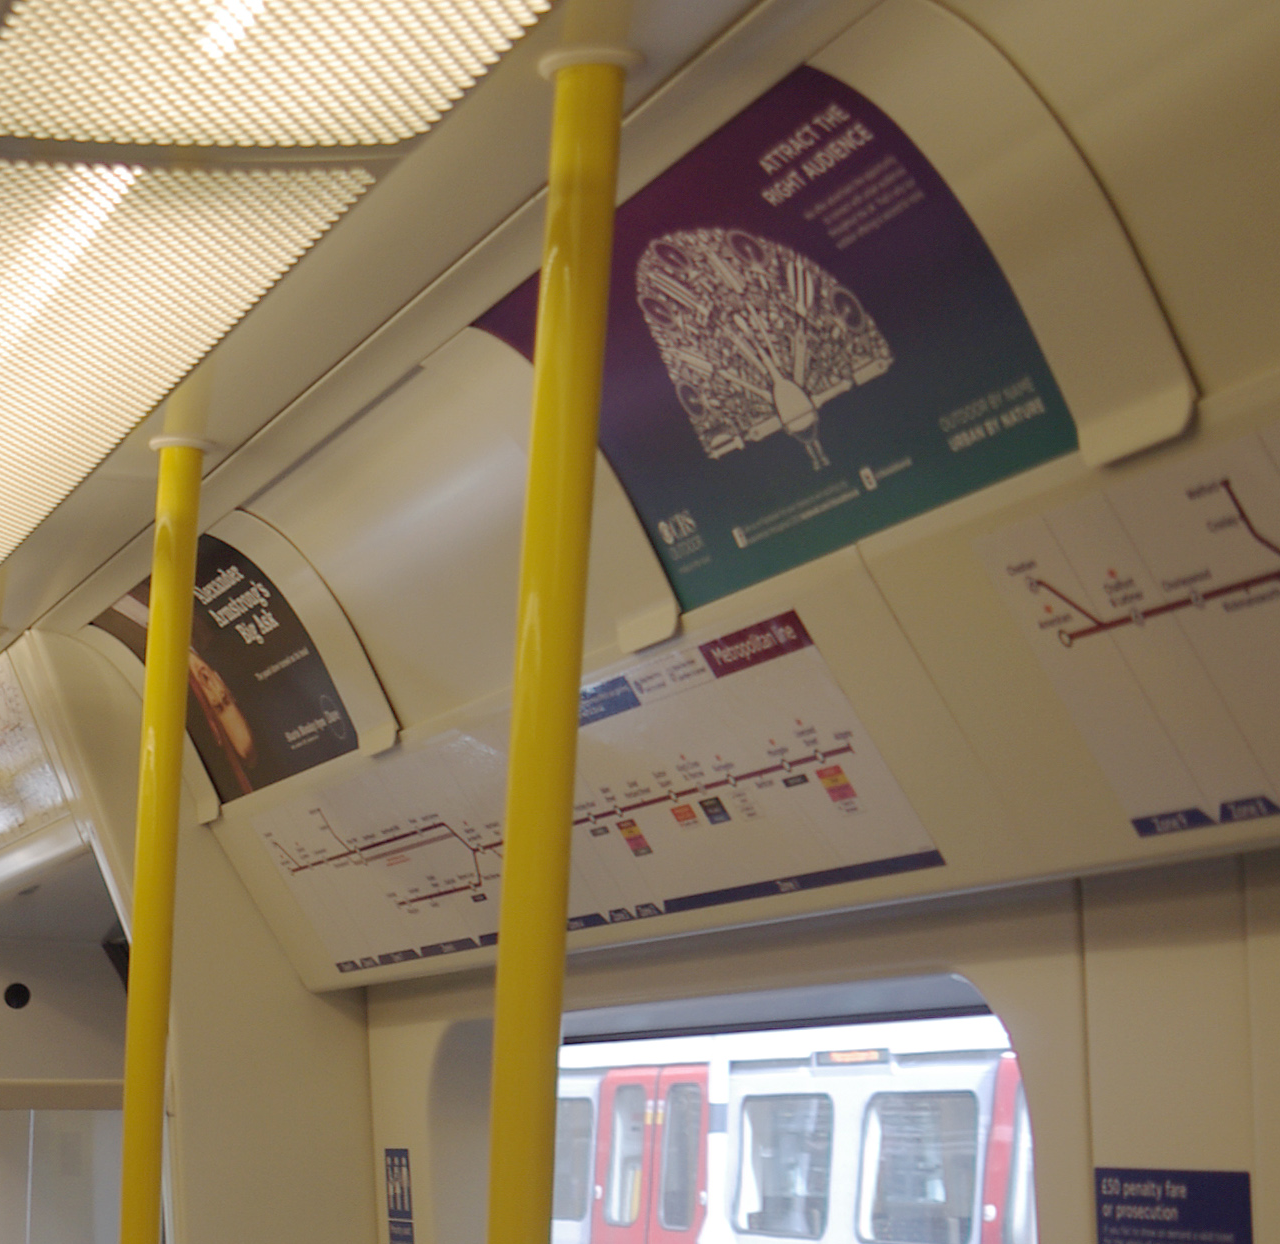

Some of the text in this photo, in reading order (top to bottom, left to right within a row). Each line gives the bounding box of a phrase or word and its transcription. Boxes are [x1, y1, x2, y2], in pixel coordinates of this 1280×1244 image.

[759, 103, 851, 176] ATTRACT THE
[761, 169, 807, 207] RIGHT
[801, 121, 874, 181] AUDIENCE
[999, 396, 1046, 429] NATURE
[193, 565, 245, 606] Alexander
[207, 580, 272, 629] Armstrong's
[234, 608, 280, 646] Big Ask
[710, 622, 798, 667] Metropolitan line
[1101, 1177, 1188, 1202] £50 penalty fare
[1101, 1203, 1180, 1222] or prosecution
